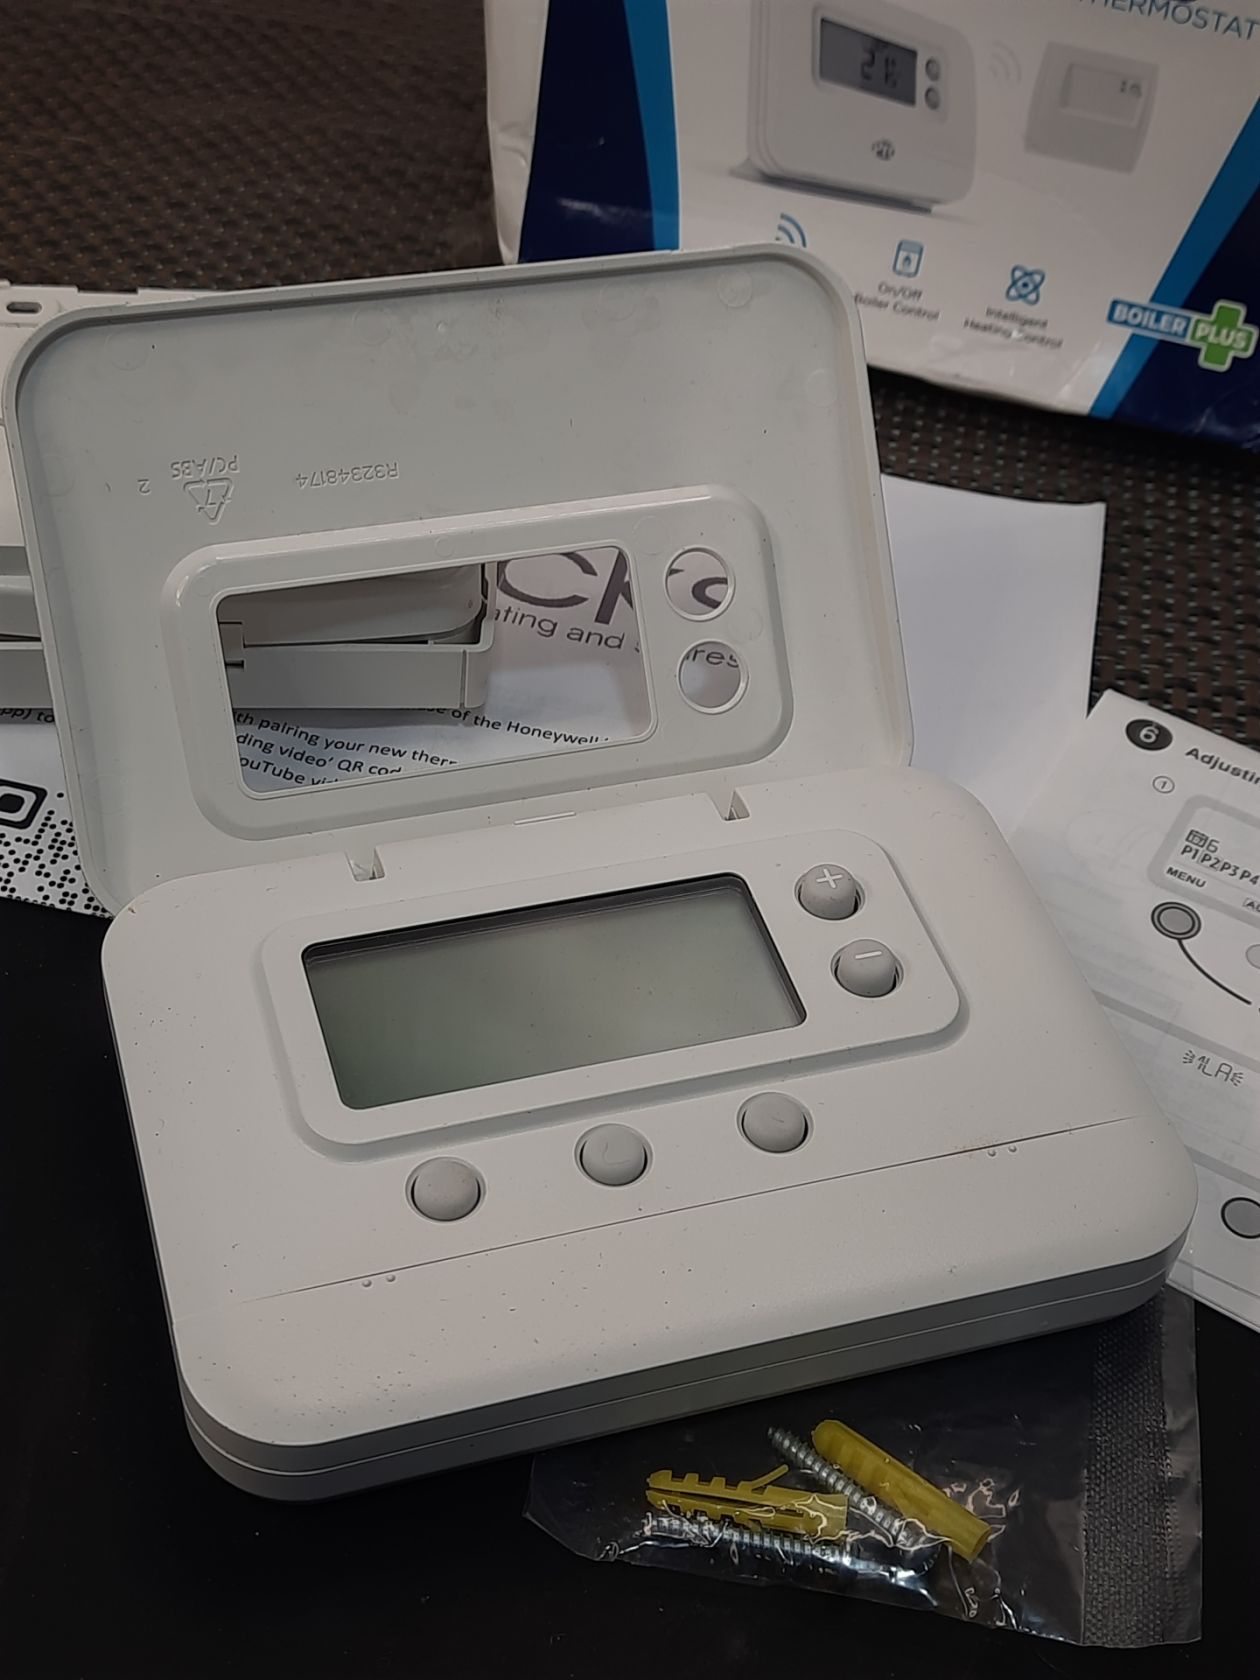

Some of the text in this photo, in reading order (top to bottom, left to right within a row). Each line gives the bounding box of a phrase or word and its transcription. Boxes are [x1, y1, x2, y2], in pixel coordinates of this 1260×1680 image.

[1080, 0, 1260, 40] ERMOSTAT
[1113, 303, 1188, 336] BOILER
[1195, 321, 1248, 350] PLUS
[170, 455, 240, 478] PC/ABS
[296, 461, 400, 489] R32348174
[494, 605, 559, 637] ting
[567, 627, 626, 649] and
[451, 709, 472, 722] of
[474, 716, 502, 730] the
[1140, 724, 1160, 743] 6
[237, 732, 275, 754] ding
[338, 760, 364, 773] QR
[258, 718, 320, 747] pairing
[324, 737, 365, 752] your
[369, 745, 407, 758] new
[412, 750, 457, 767] ther
[240, 757, 306, 785] ouTube
[1206, 839, 1220, 853] 6
[1181, 845, 1199, 860] P1
[1201, 853, 1220, 868] P2
[1220, 862, 1240, 876] P3
[1166, 867, 1207, 888] MENU
